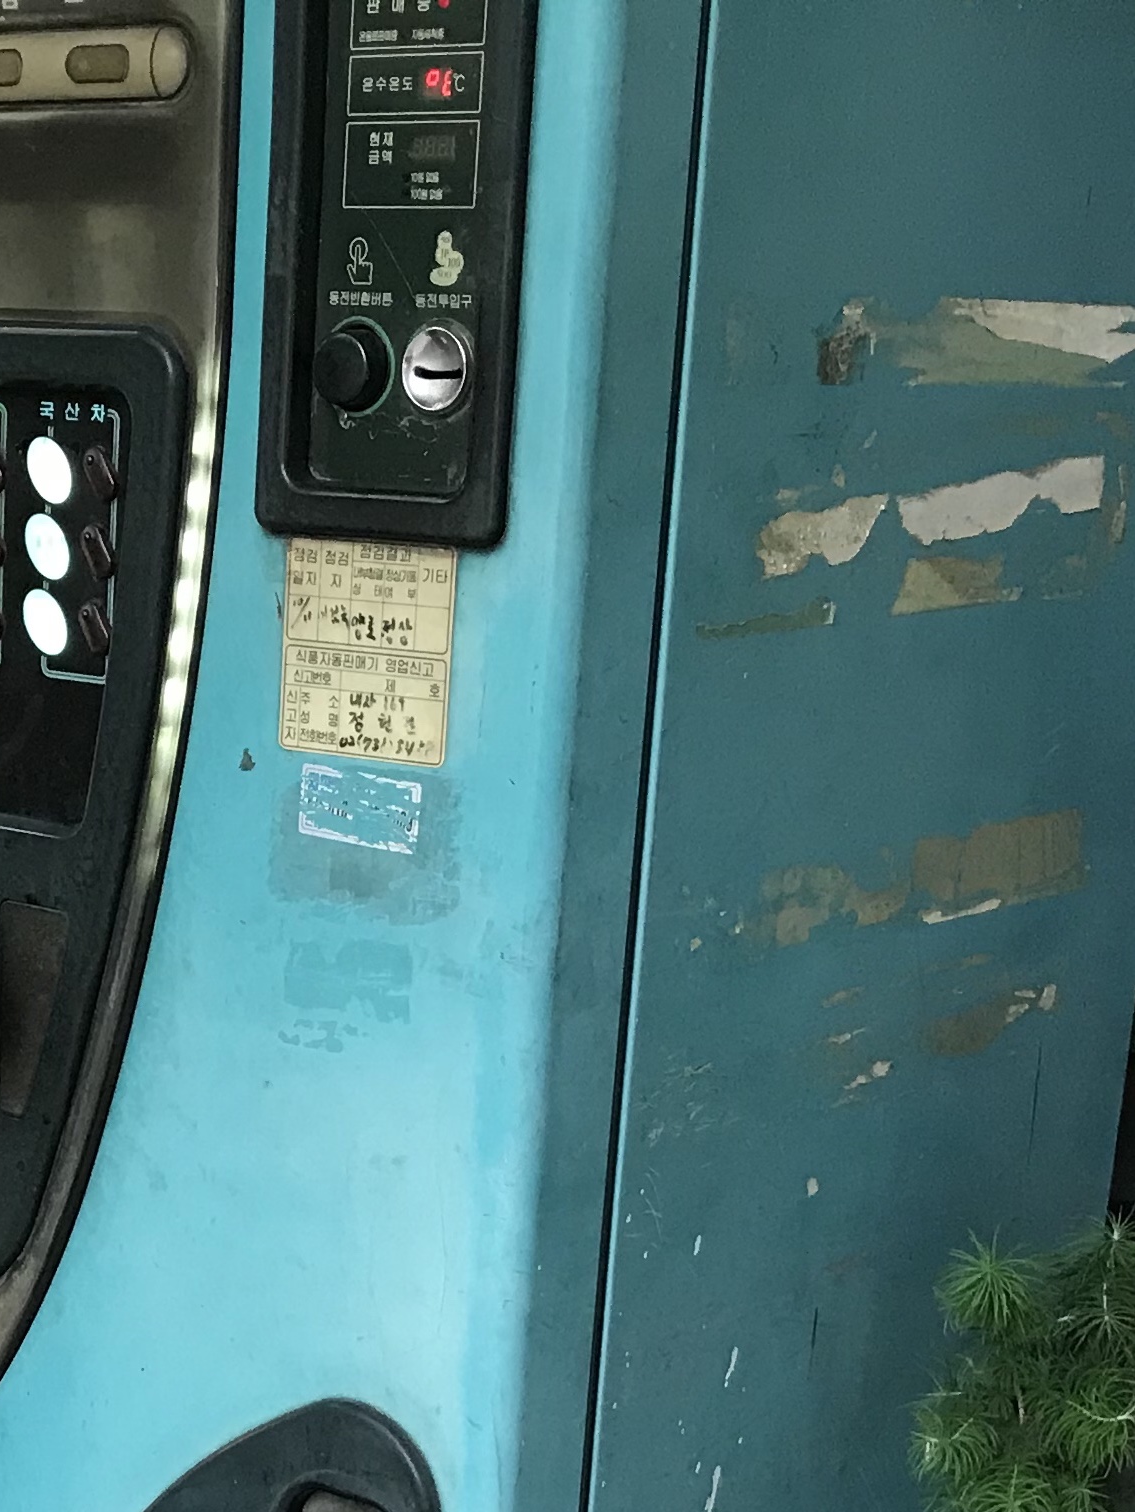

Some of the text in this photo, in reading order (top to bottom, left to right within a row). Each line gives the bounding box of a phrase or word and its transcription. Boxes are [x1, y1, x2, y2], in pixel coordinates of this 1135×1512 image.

[362, 76, 413, 92] 온수온도
[415, 293, 472, 309] 동전투입구
[294, 547, 318, 563] 점검
[325, 550, 349, 566] 점검
[360, 544, 412, 562] 점검결과
[293, 571, 317, 585] 일자
[422, 567, 448, 584] 기타
[296, 649, 434, 677] 식품자동판매기 영업신고
[294, 669, 331, 686] 신고번호
[429, 683, 440, 698] 호
[300, 728, 337, 745] 전화번호
